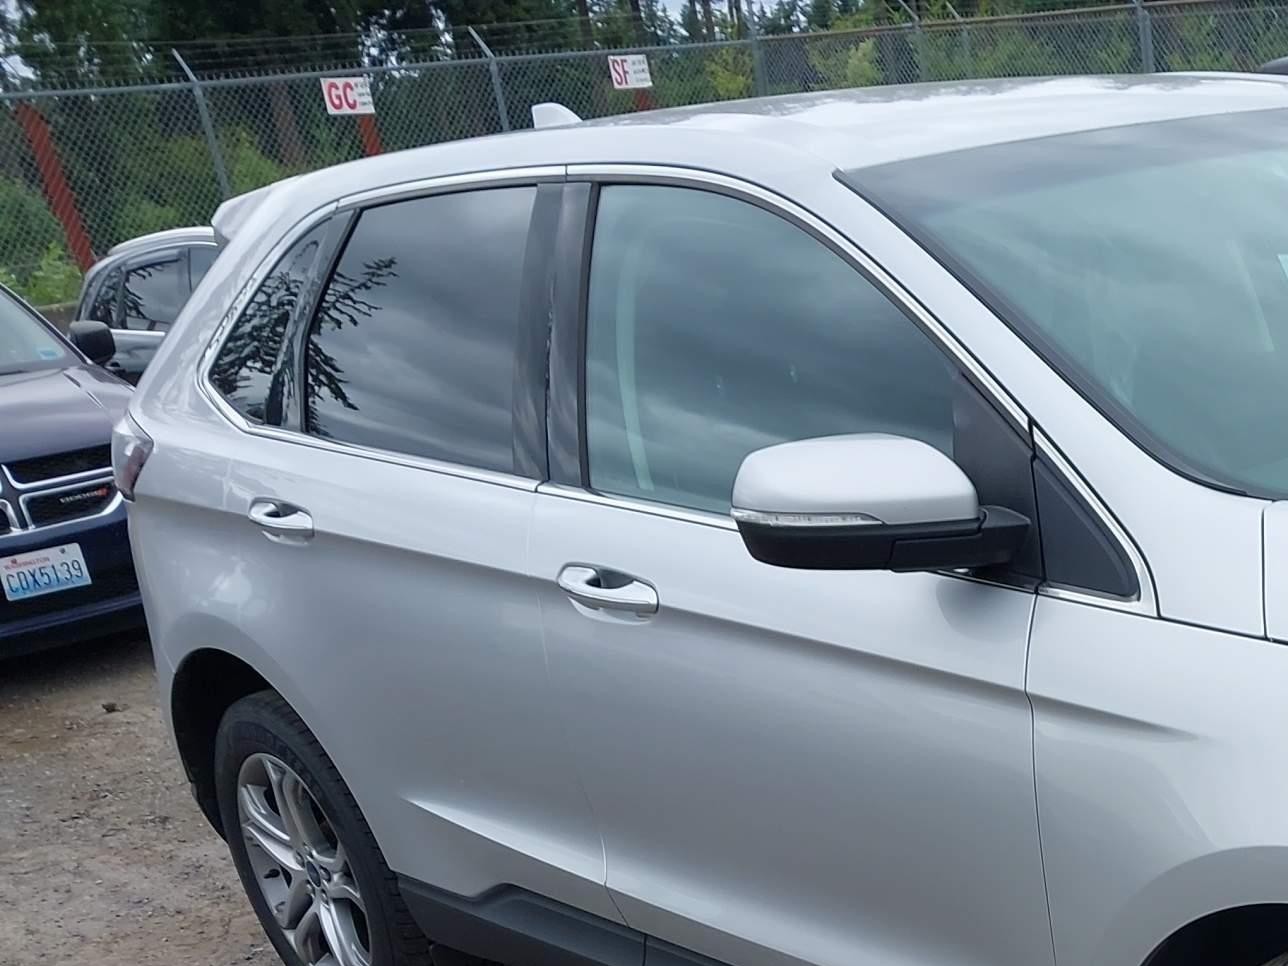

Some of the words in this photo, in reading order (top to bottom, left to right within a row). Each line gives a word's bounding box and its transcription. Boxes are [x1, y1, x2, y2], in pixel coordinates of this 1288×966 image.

[610, 58, 629, 86] SF
[327, 81, 357, 110] GC
[6, 559, 84, 593] CDX5139
